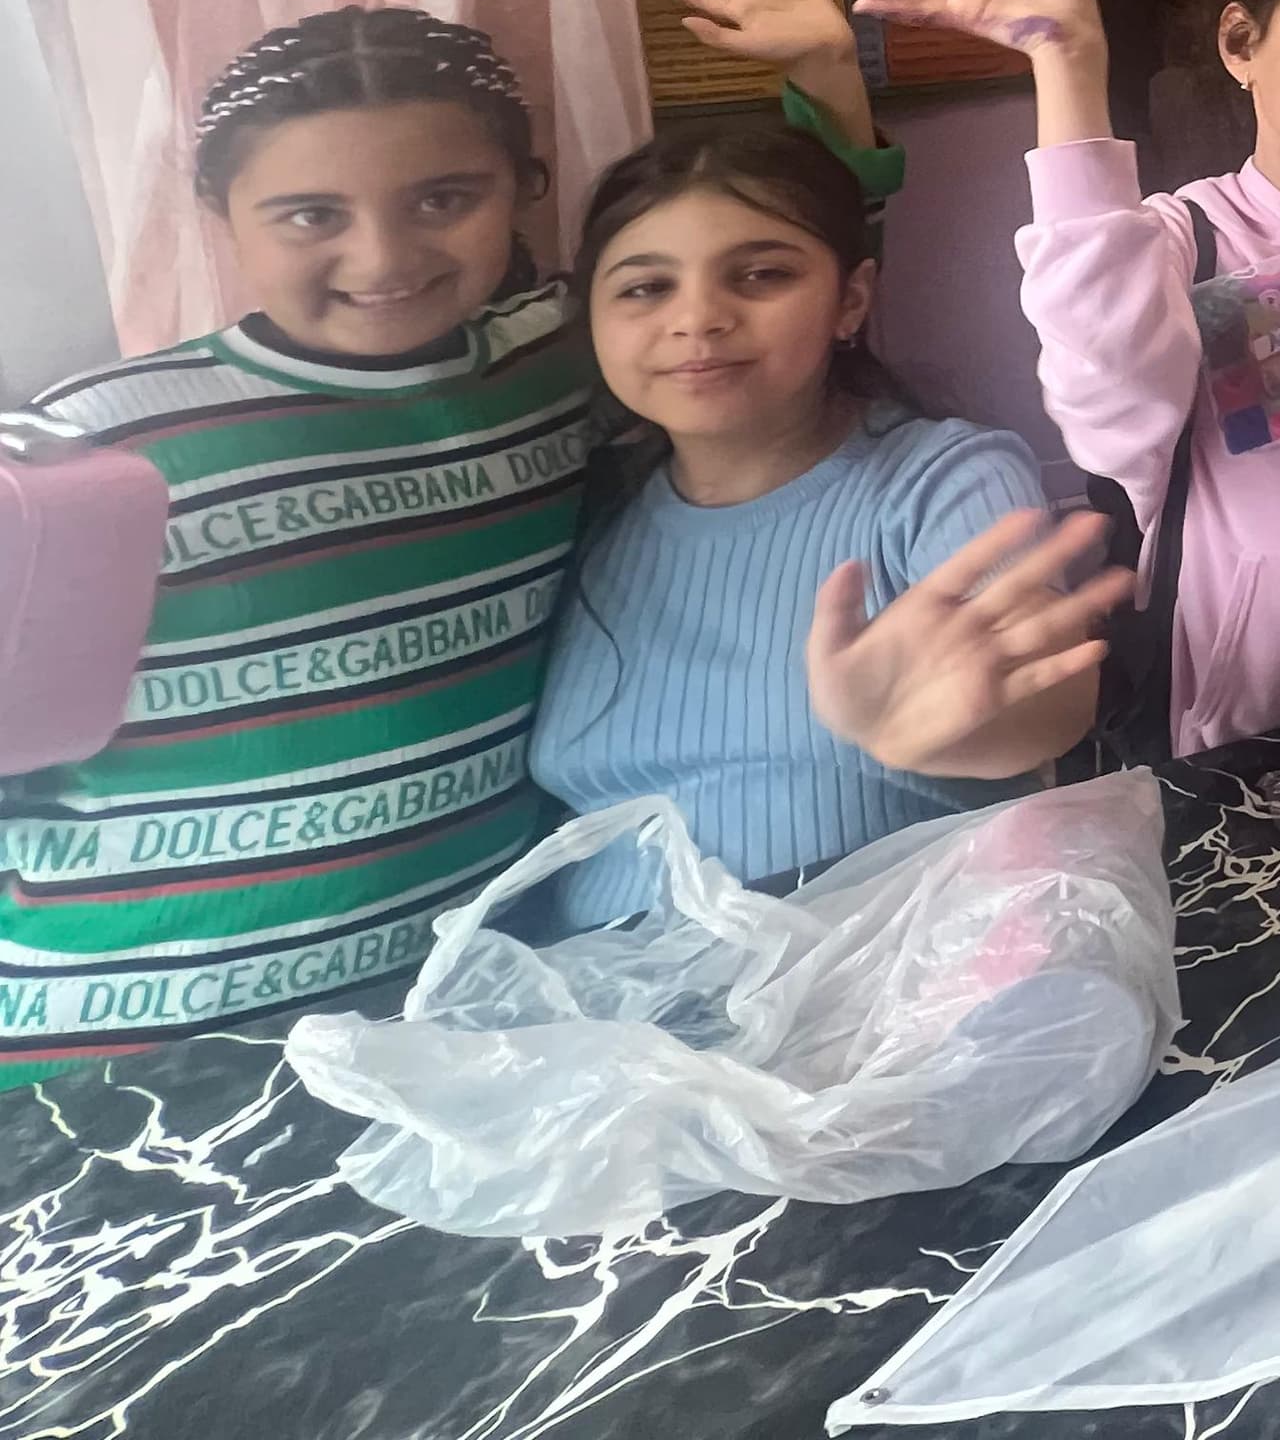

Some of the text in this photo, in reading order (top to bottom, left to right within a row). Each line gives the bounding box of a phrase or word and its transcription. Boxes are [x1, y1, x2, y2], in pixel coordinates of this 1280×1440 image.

[162, 464, 495, 564] LCE&GABBANA
[143, 595, 513, 714] DOLCE&GABBANA
[130, 746, 523, 863] DOLCE&GABBANA
